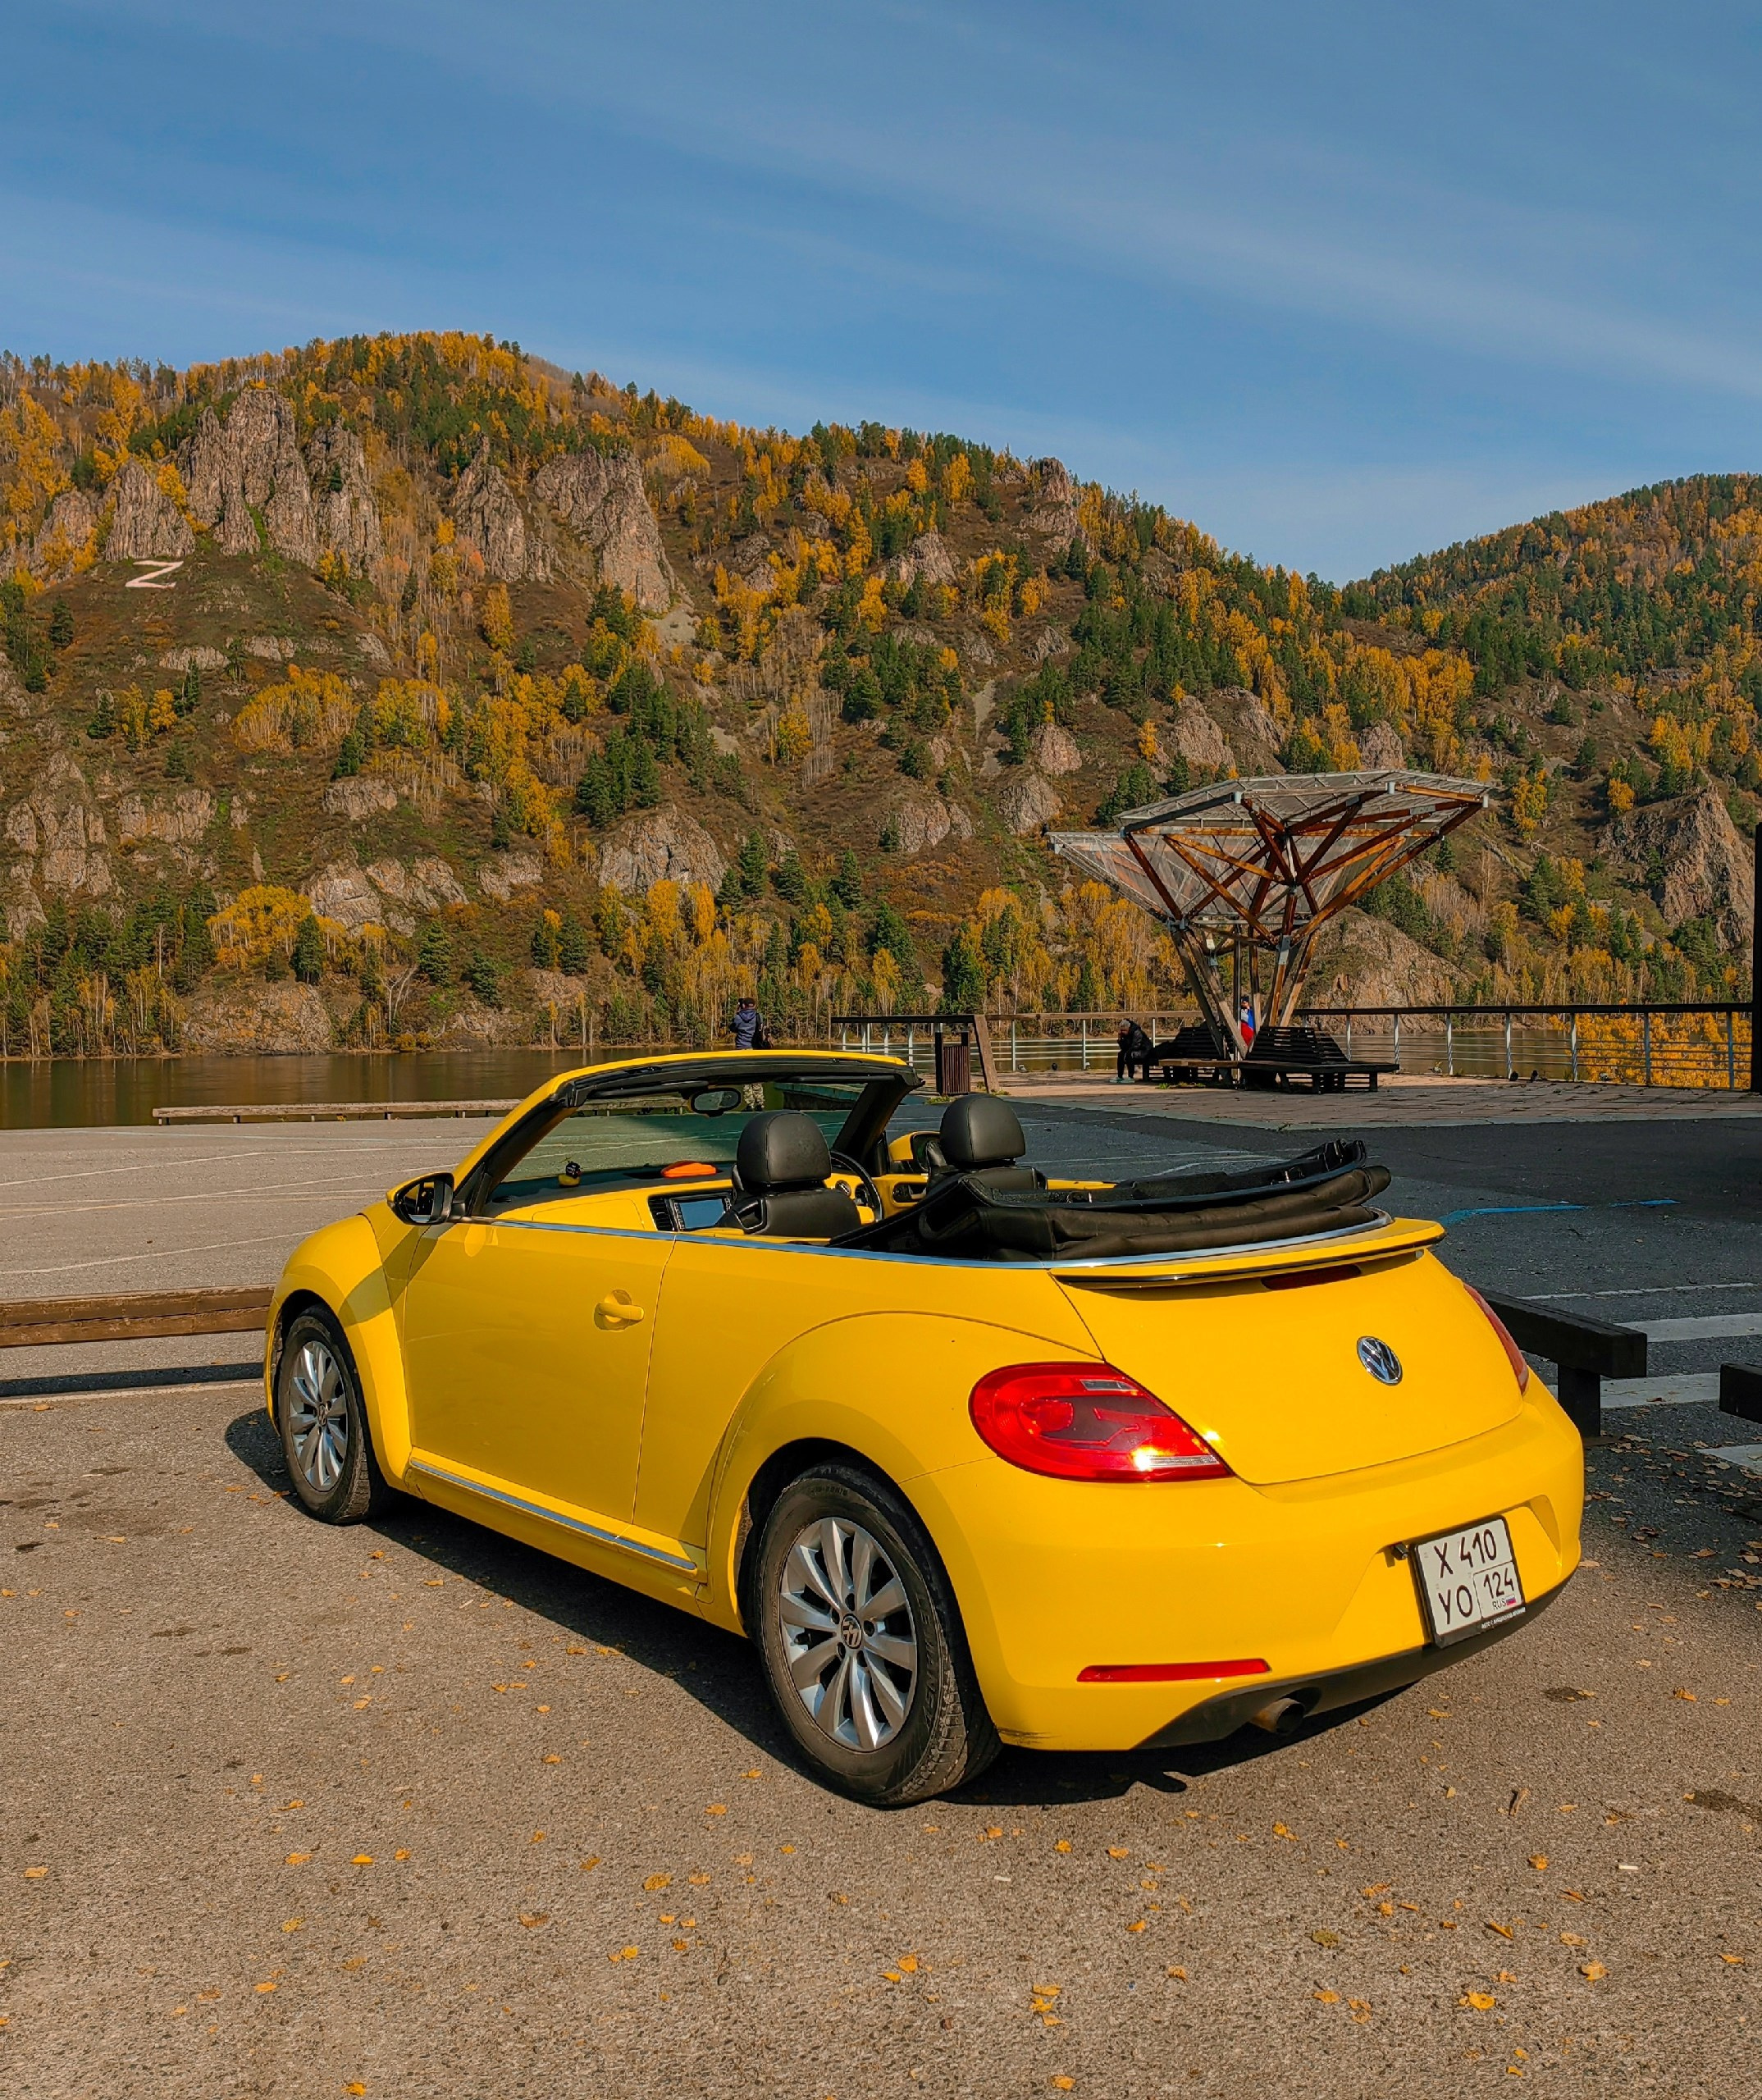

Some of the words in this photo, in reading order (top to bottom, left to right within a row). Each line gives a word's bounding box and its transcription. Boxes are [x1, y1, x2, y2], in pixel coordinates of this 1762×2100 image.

[126, 560, 184, 589] Z
[1459, 1529, 1497, 1568] 410
[1483, 1568, 1515, 1599] 124
[1492, 1598, 1507, 1610] RUS
